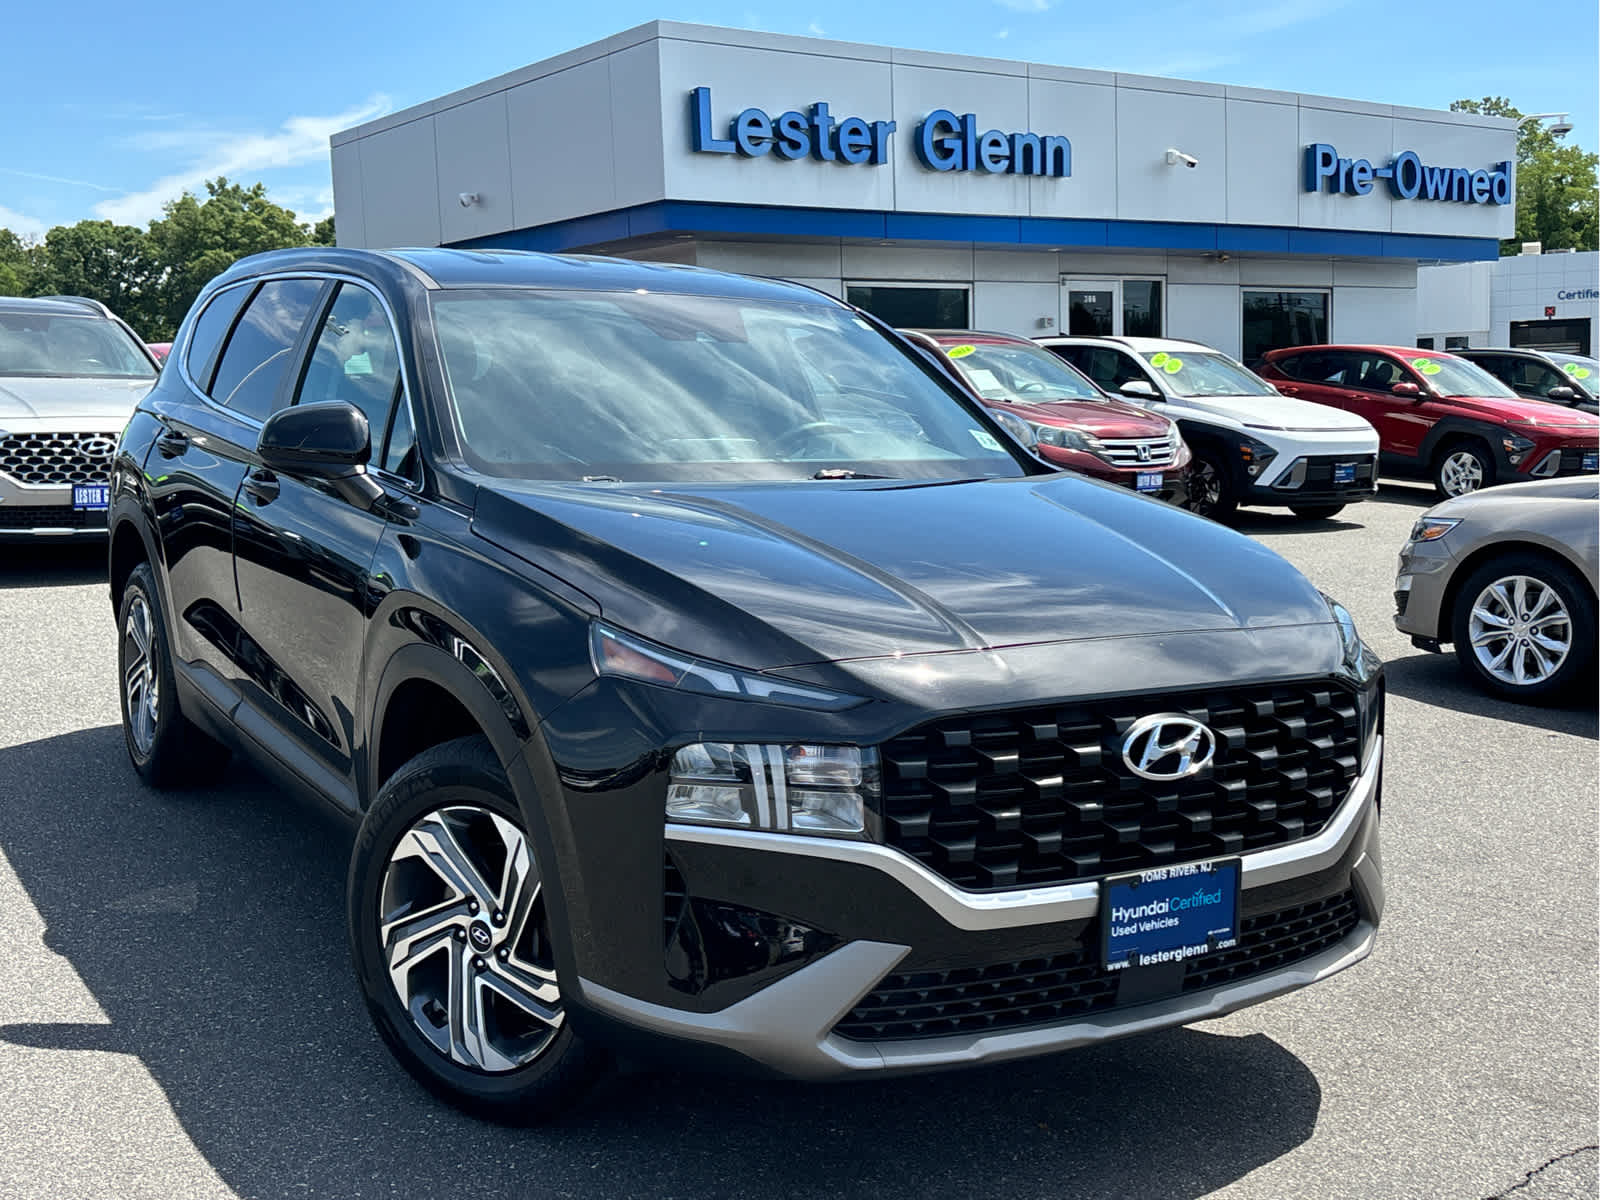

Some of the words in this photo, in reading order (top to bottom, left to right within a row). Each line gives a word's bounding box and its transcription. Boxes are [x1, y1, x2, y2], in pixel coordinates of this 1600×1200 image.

[689, 86, 897, 165] Lester
[914, 109, 1073, 178] Glenn
[1306, 143, 1512, 205] Pre-Owned
[75, 487, 101, 503] LESTER
[1140, 869, 1167, 883] TOMS
[1111, 898, 1169, 923] Hyundai
[1170, 888, 1221, 911] Certified
[1111, 922, 1137, 937] Used
[1138, 917, 1180, 932] Vehicles
[1107, 961, 1131, 971] www.
[1139, 944, 1208, 966] lesterglenn
[1216, 938, 1237, 950] .com
